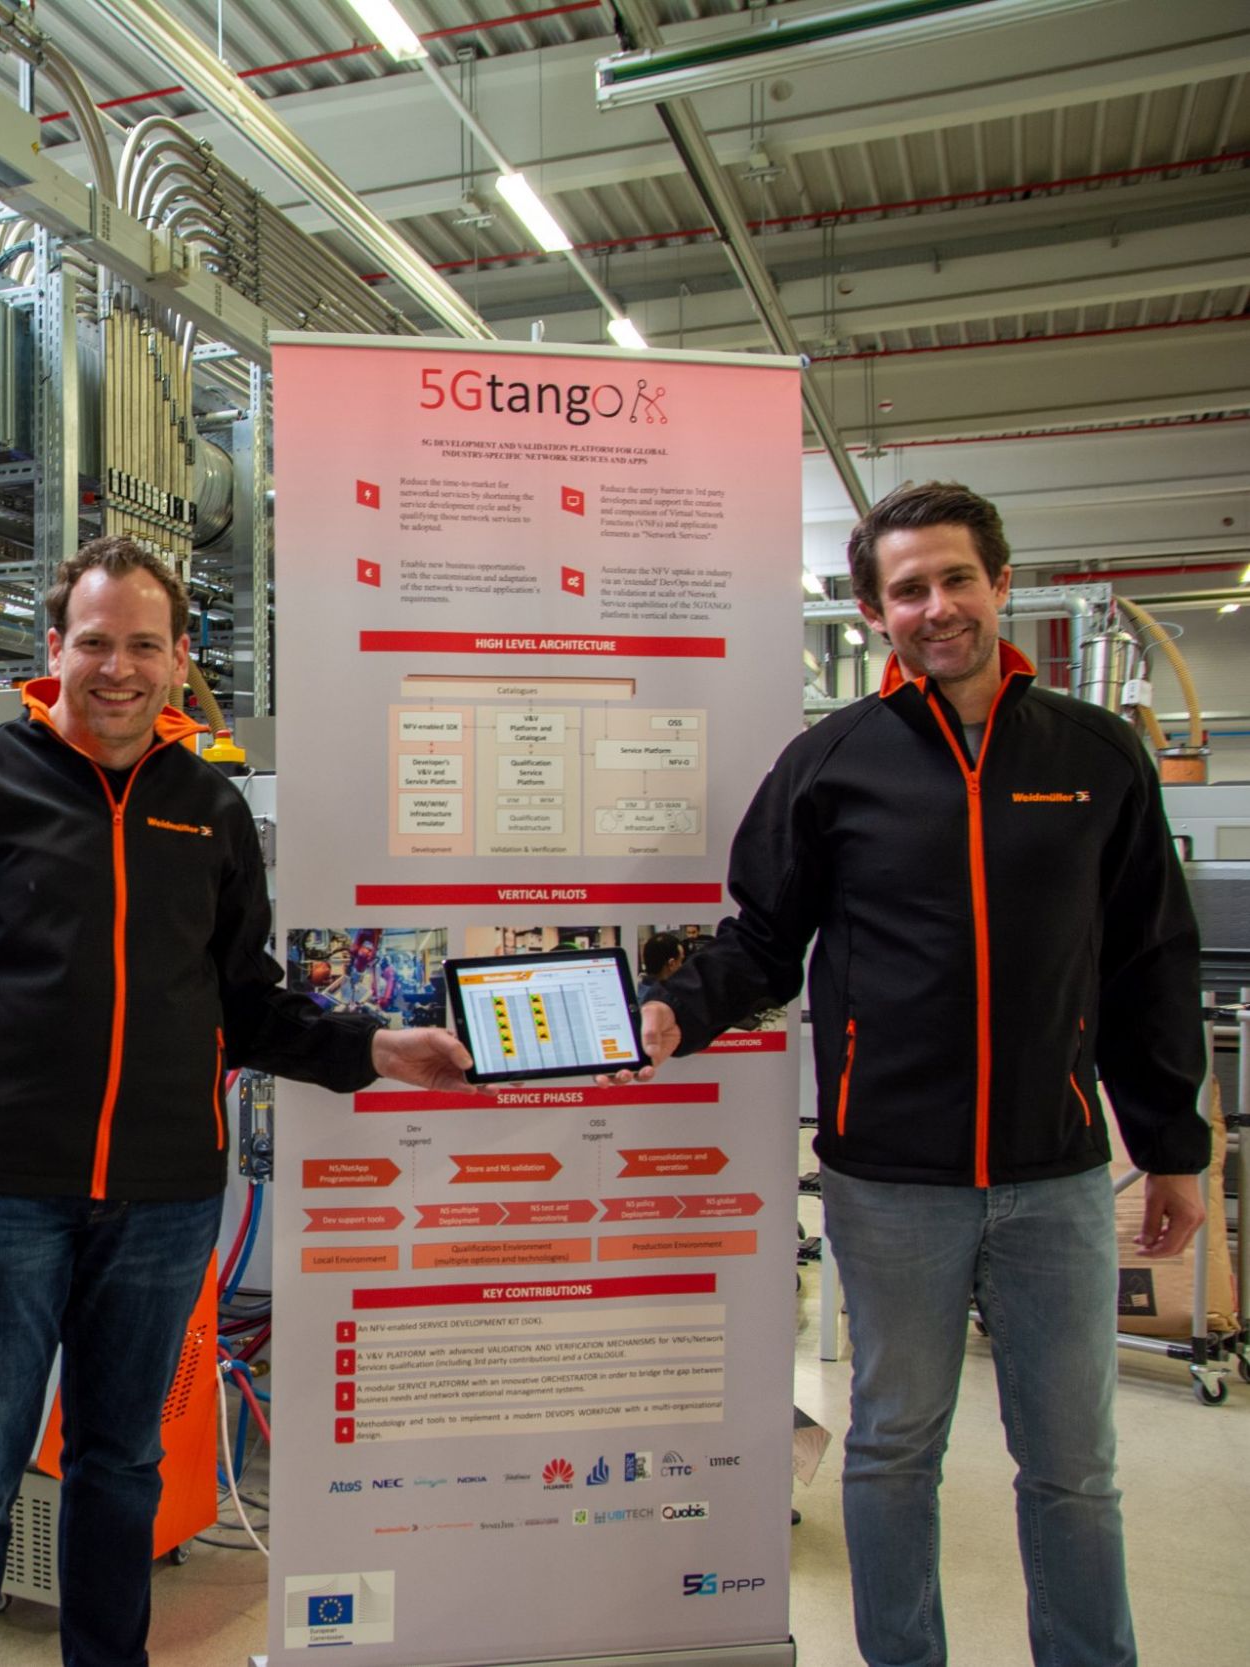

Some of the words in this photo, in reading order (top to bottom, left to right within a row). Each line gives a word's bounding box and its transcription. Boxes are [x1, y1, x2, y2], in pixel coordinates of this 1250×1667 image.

[422, 439, 432, 447] 5G
[434, 439, 497, 449] DEVELOPMENT
[498, 441, 515, 450] AND
[517, 442, 568, 452] VALIDATION
[570, 444, 614, 453] PLATFORM
[615, 446, 632, 454] FOR
[633, 446, 668, 455] GLOBAL
[442, 449, 522, 460] INDUSTRY-SPECIFIC
[525, 453, 568, 462] NETWORK
[569, 454, 608, 464] SERVICES
[609, 456, 627, 464] AND
[628, 456, 648, 465] APPS
[475, 638, 503, 649] HIGH
[505, 639, 536, 650] LEVEL
[540, 639, 616, 651] ARCHITECTURE
[497, 687, 537, 696] Catalogues
[668, 719, 683, 727] OSS
[498, 888, 549, 901] VERTICAL
[551, 888, 587, 900] PILOTS
[497, 1092, 541, 1105] SERVICE
[543, 1092, 583, 1103] PHASES
[589, 1119, 606, 1127] OSS
[406, 1125, 422, 1133] Dev
[582, 1132, 613, 1141] triggered
[399, 1137, 431, 1147] triggered
[649, 1153, 693, 1161] consolidation
[466, 1165, 483, 1173] Store
[485, 1165, 499, 1173] and
[512, 1163, 545, 1172] validation
[656, 1164, 688, 1172] operation
[319, 1174, 378, 1184] Programmability
[323, 1216, 336, 1224] Dev
[338, 1217, 365, 1225] support
[367, 1215, 385, 1223] tools
[451, 1245, 501, 1254] Qualification
[503, 1243, 552, 1252] Environment
[633, 1242, 672, 1251] Production
[674, 1240, 722, 1250] Environment
[313, 1256, 333, 1264] Local
[335, 1255, 387, 1264] Environment
[482, 1287, 504, 1299] KEY
[505, 1284, 592, 1298] CONTRIBUTIONS
[357, 1325, 368, 1333] An
[370, 1323, 417, 1332] NFV-enabled
[419, 1321, 448, 1330] SERVICE
[450, 1319, 507, 1328] DEVELOPMENT
[509, 1318, 519, 1326] KIT
[343, 1328, 349, 1337] 1
[357, 1352, 362, 1360] A
[366, 1351, 383, 1359] V&V
[387, 1350, 426, 1358] PLATFORM
[429, 1349, 445, 1357] with
[449, 1347, 484, 1356] advanced
[488, 1345, 531, 1354] VALIDATION
[535, 1343, 552, 1351] AND
[555, 1340, 603, 1350] VERIFICATION
[607, 1338, 656, 1347] MECHANISMS
[658, 1337, 668, 1345] for
[672, 1335, 723, 1345] VNFs/Network
[343, 1359, 349, 1367] 2
[356, 1418, 405, 1430] Methodology
[410, 1417, 423, 1425] and
[427, 1416, 445, 1424] tools
[449, 1415, 456, 1423] to
[460, 1413, 500, 1424] implement
[513, 1411, 541, 1420] modern
[545, 1409, 575, 1418] DEVOPS
[578, 1406, 621, 1416] WORKFLOW
[625, 1405, 640, 1413] with
[652, 1400, 722, 1414] multi-organizational
[356, 1431, 382, 1441] design.
[660, 1465, 693, 1477] CTTC
[372, 1478, 404, 1489] NEC
[457, 1476, 487, 1484] NOKIA
[543, 1483, 573, 1491] HUAWEI
[607, 1508, 654, 1520] UBITECH
[683, 1572, 717, 1596] 5G
[722, 1577, 765, 1593] PPP
